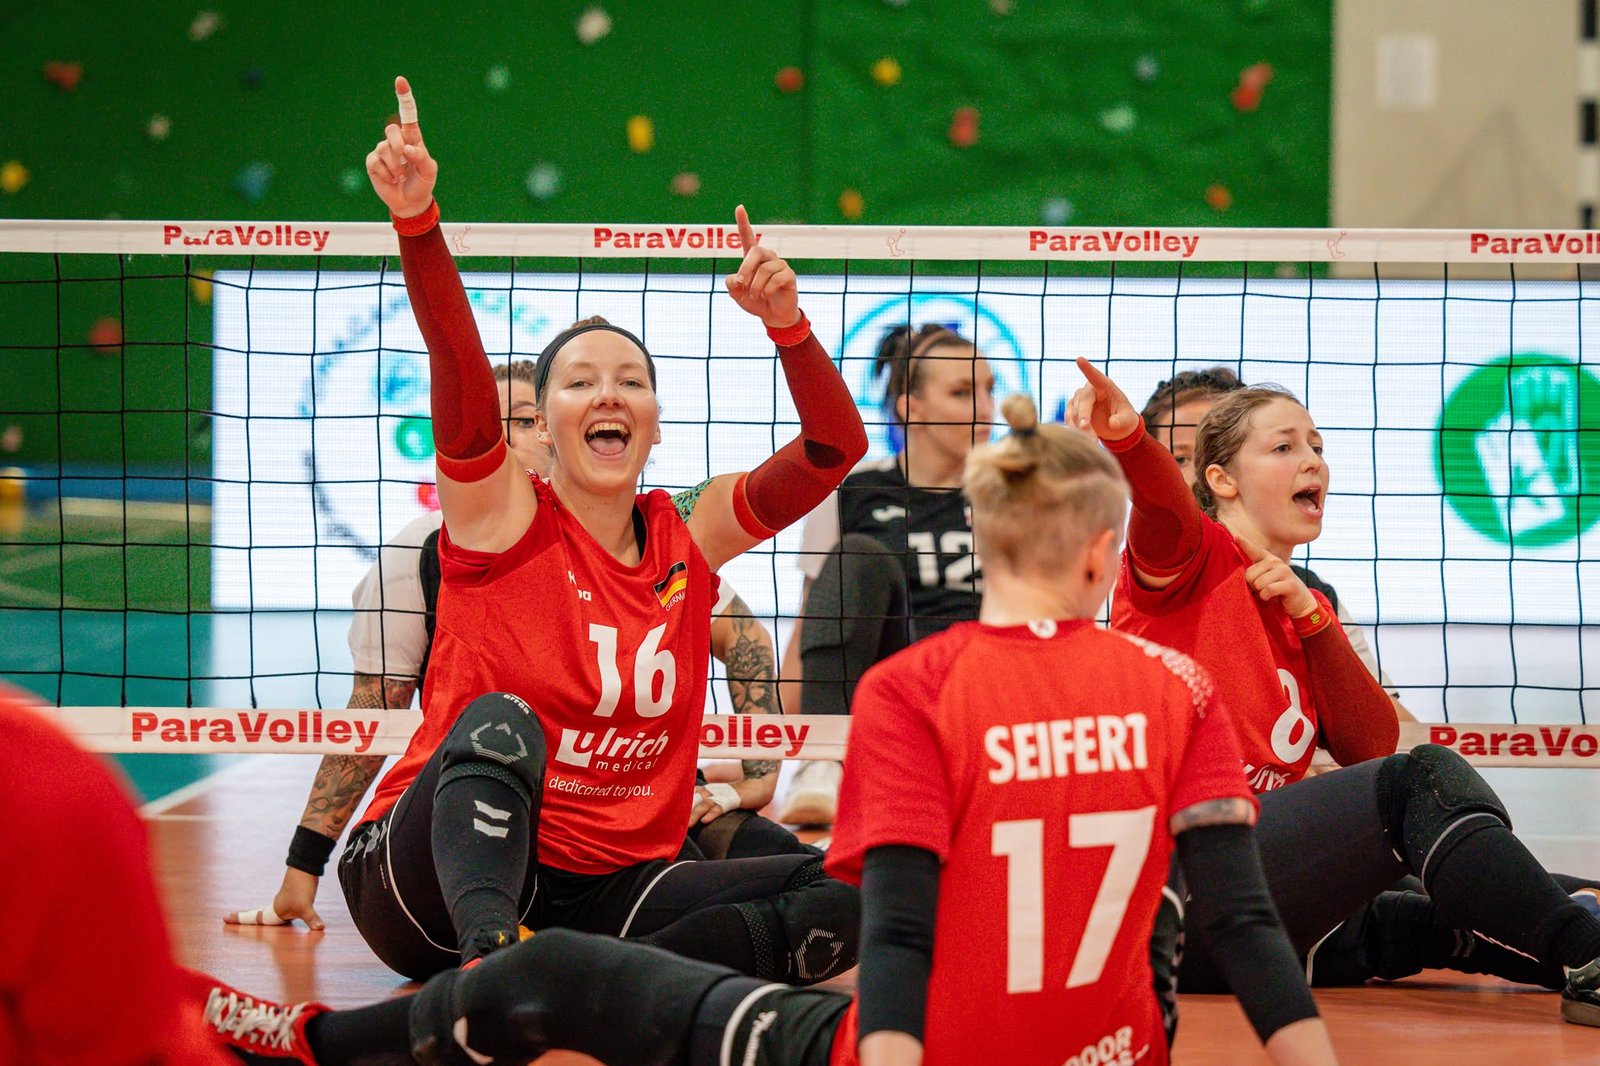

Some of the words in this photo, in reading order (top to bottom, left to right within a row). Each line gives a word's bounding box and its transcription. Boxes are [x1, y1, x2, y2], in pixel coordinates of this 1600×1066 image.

[1029, 230, 1200, 258] ParaVolley
[907, 531, 984, 594] 12
[588, 622, 677, 718] 16
[132, 711, 380, 752] ParaVolley
[984, 712, 1149, 785] SEIFERT
[548, 775, 614, 797] dedicated
[612, 784, 627, 797] to
[624, 784, 655, 800] you.
[595, 758, 658, 772] medical
[991, 805, 1158, 994] 17
